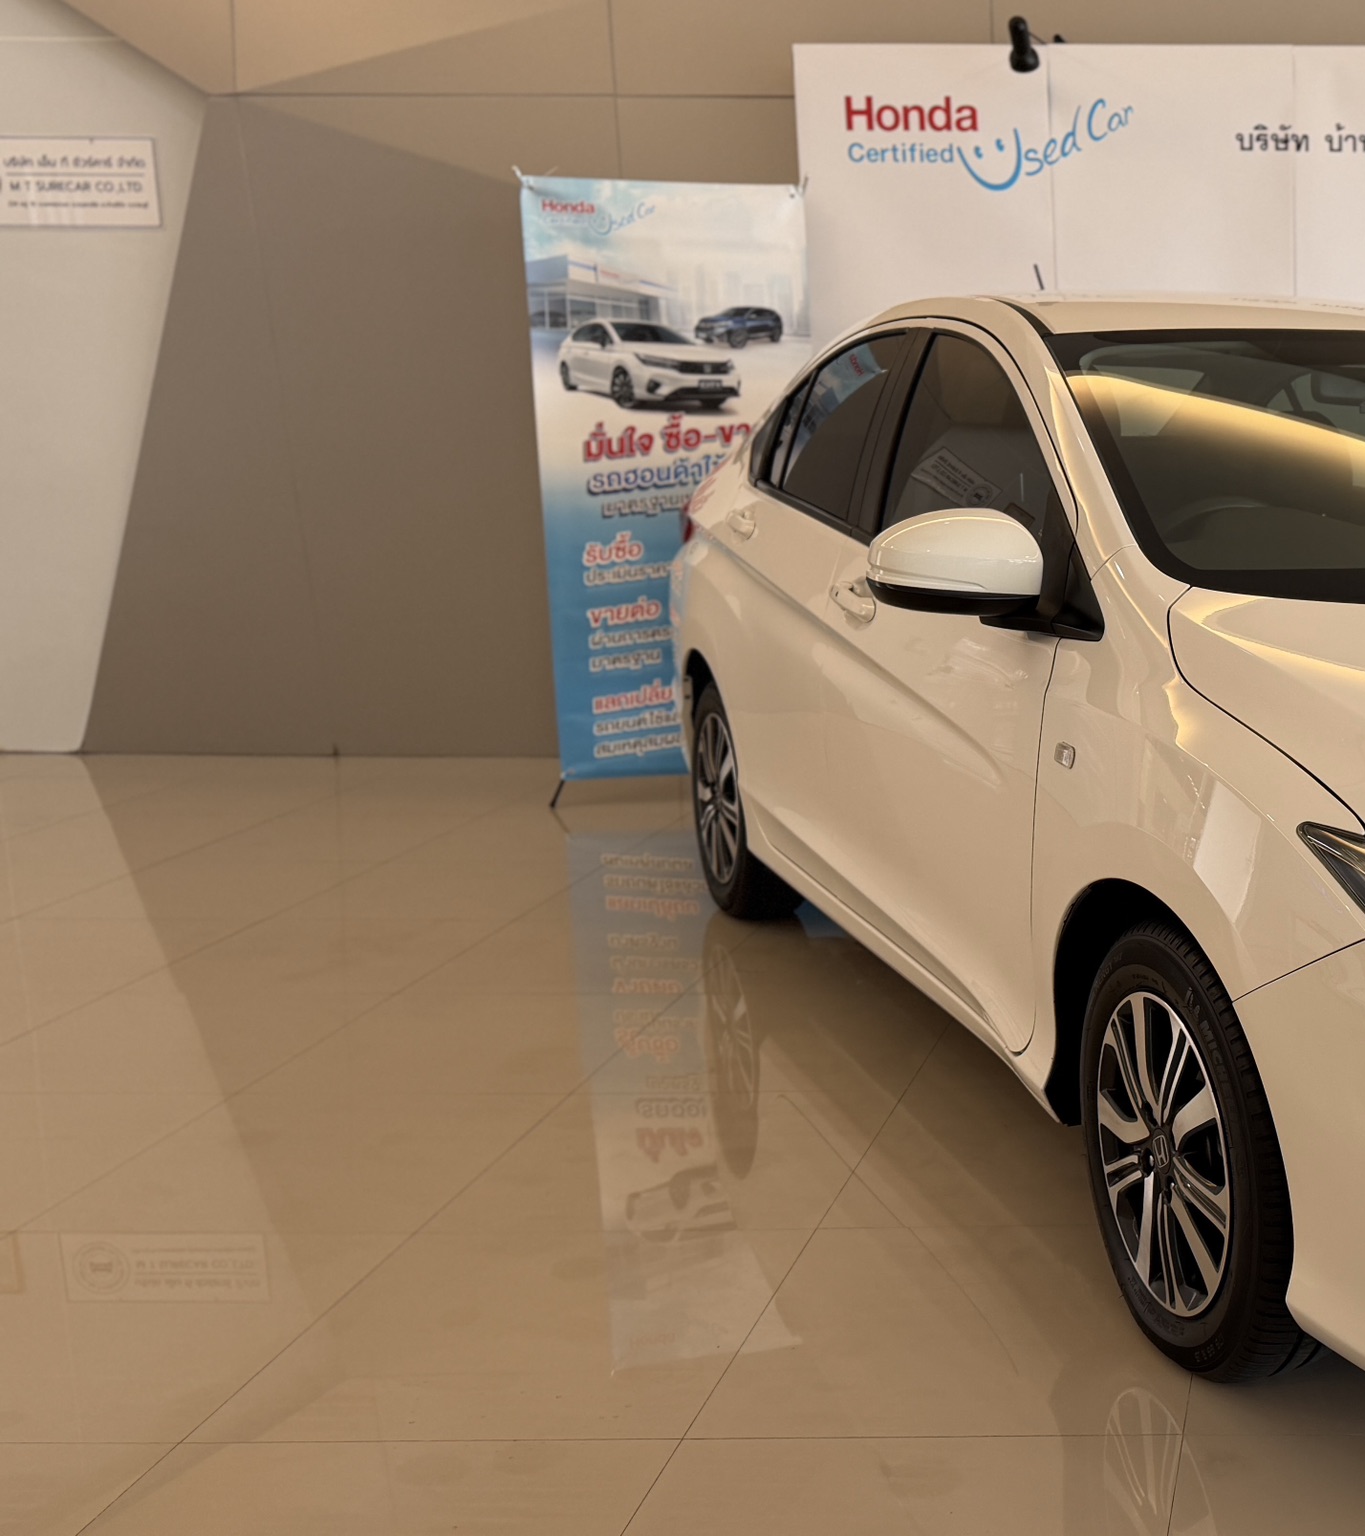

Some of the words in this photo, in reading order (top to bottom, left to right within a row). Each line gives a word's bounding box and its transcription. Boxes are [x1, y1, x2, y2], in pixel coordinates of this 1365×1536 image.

[845, 96, 979, 132] Honda
[848, 142, 954, 163] Certified
[957, 105, 1082, 191] Used
[1087, 98, 1134, 142] Car
[1235, 125, 1310, 153] บริษัท
[542, 199, 596, 214] Honda
[583, 421, 654, 461] มั่นใจ
[584, 531, 643, 564] รับซื้อ
[589, 596, 660, 625] ขายต่อ
